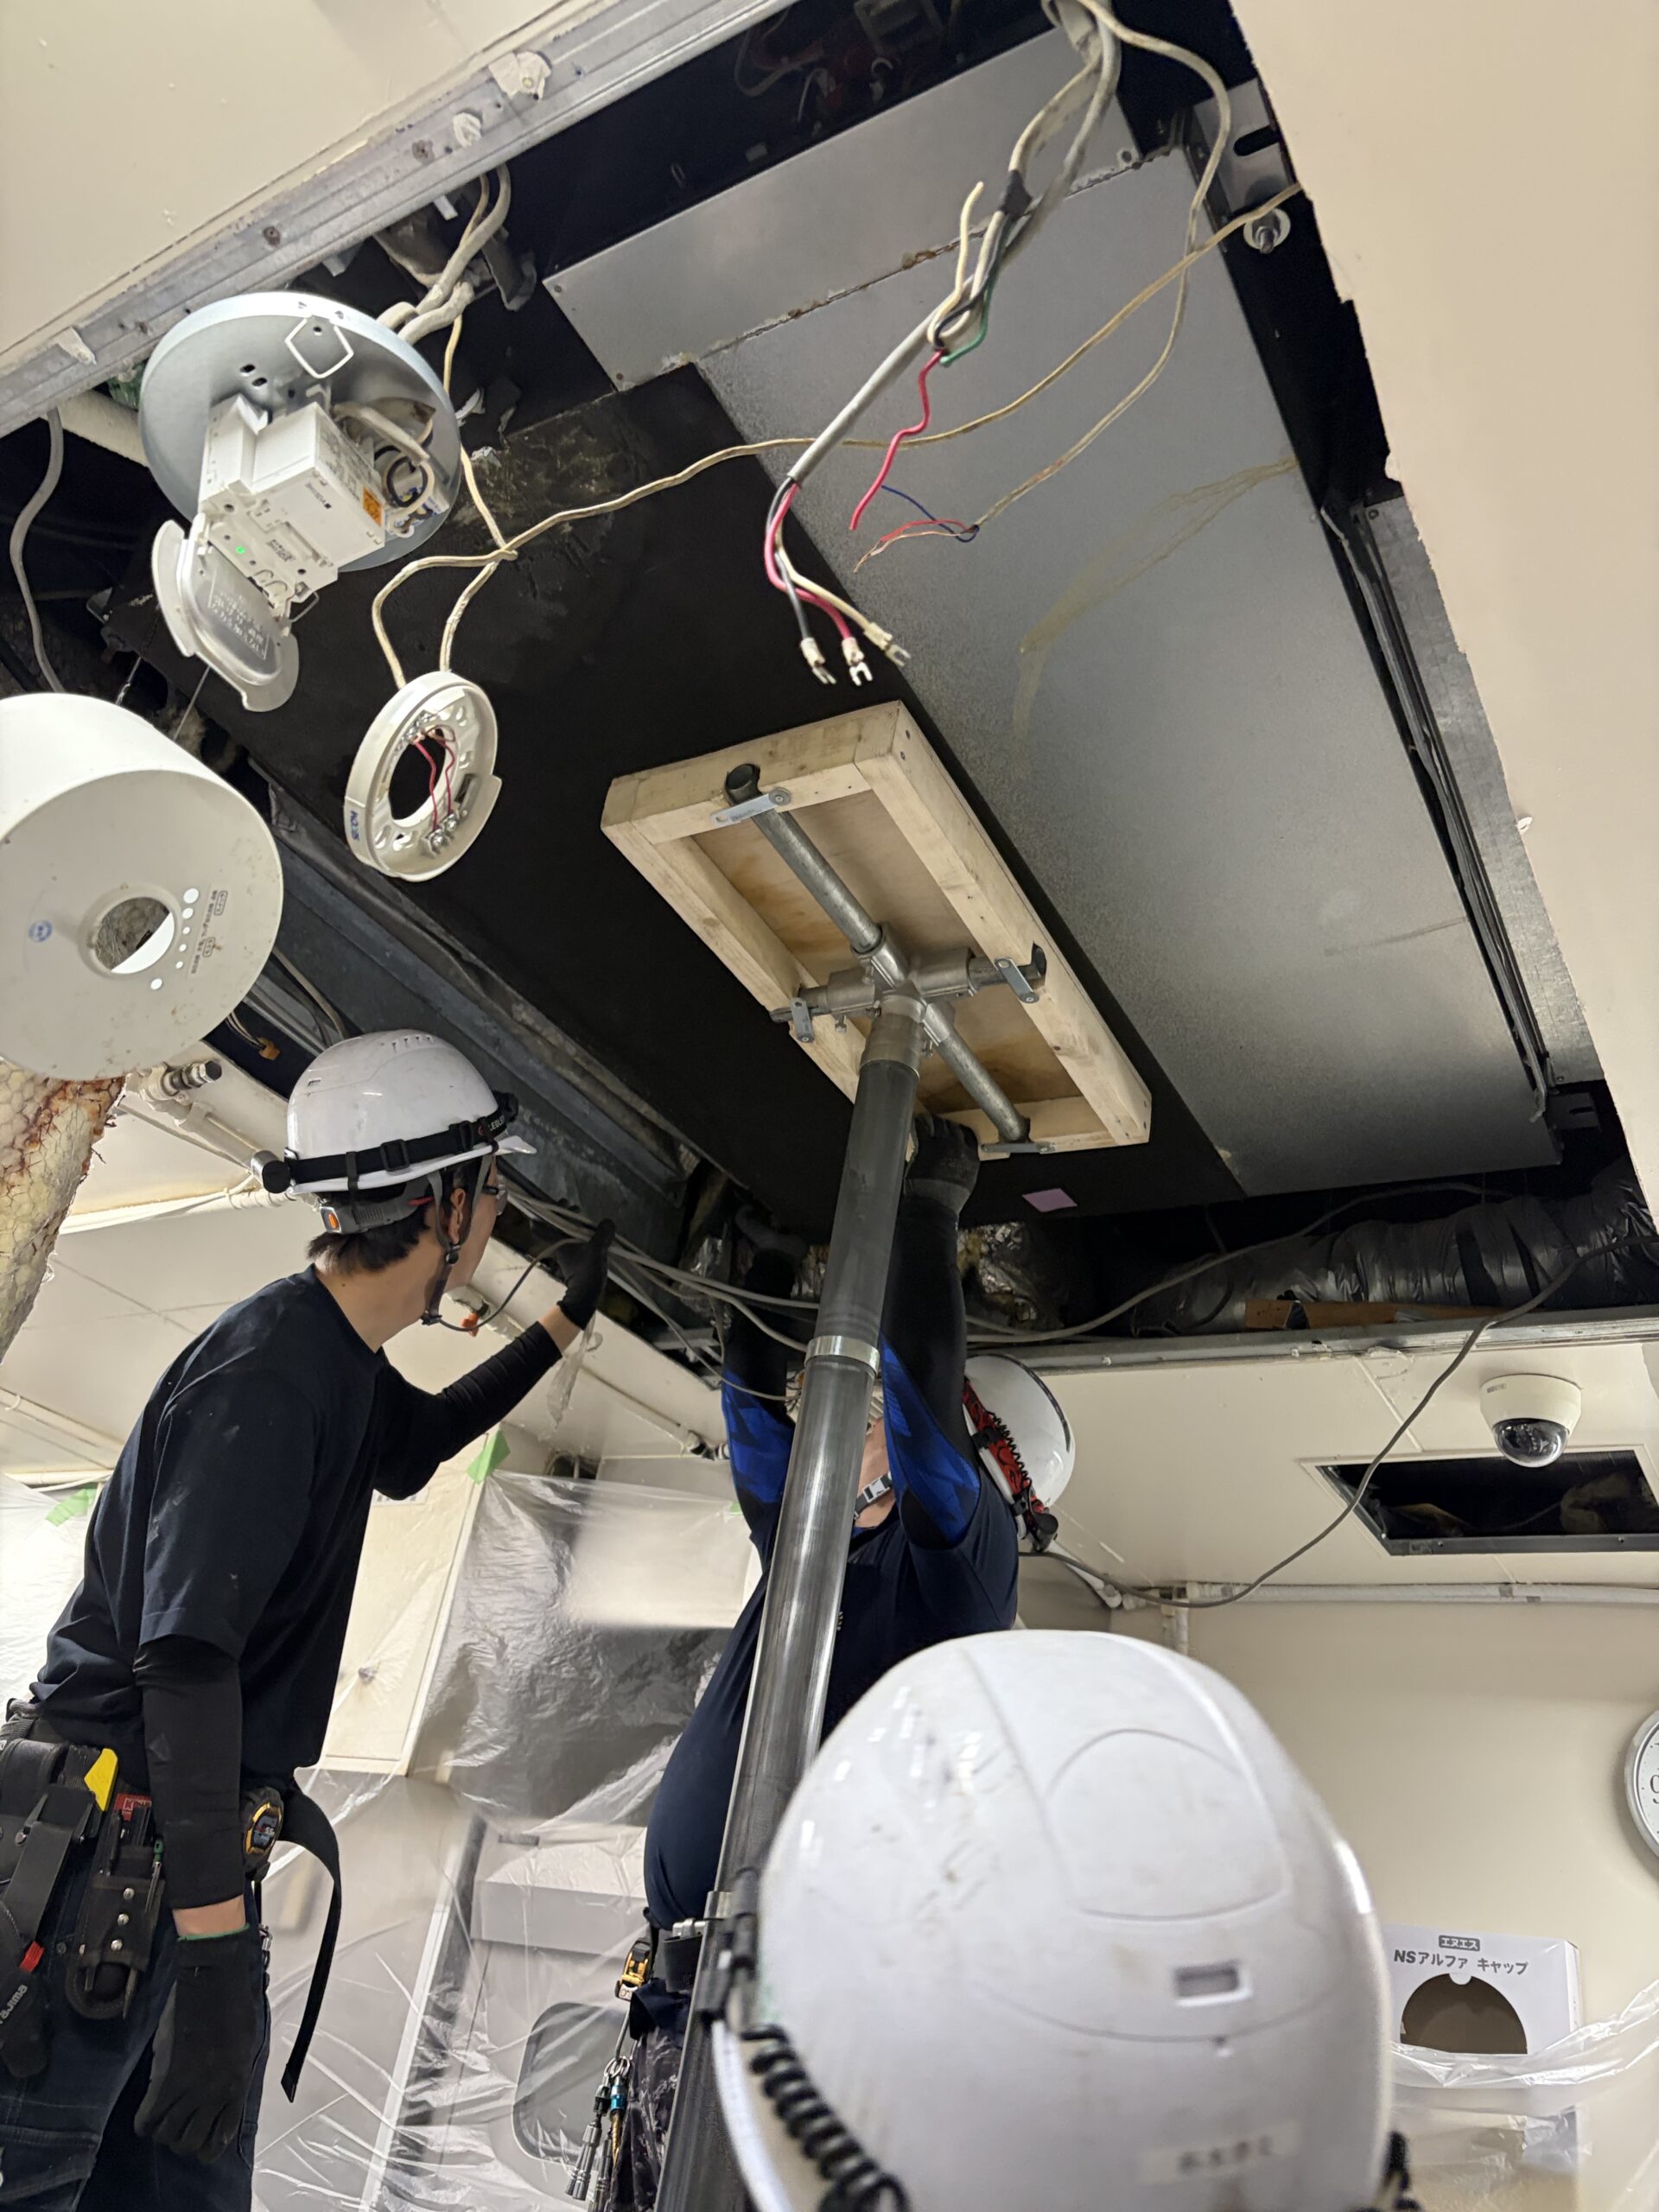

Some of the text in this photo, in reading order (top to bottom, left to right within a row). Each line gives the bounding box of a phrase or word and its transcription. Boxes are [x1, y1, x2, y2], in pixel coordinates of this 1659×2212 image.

[1440, 1936, 1479, 1951] エヌエス
[1393, 1949, 1529, 1976] NSアルファ キャップ
